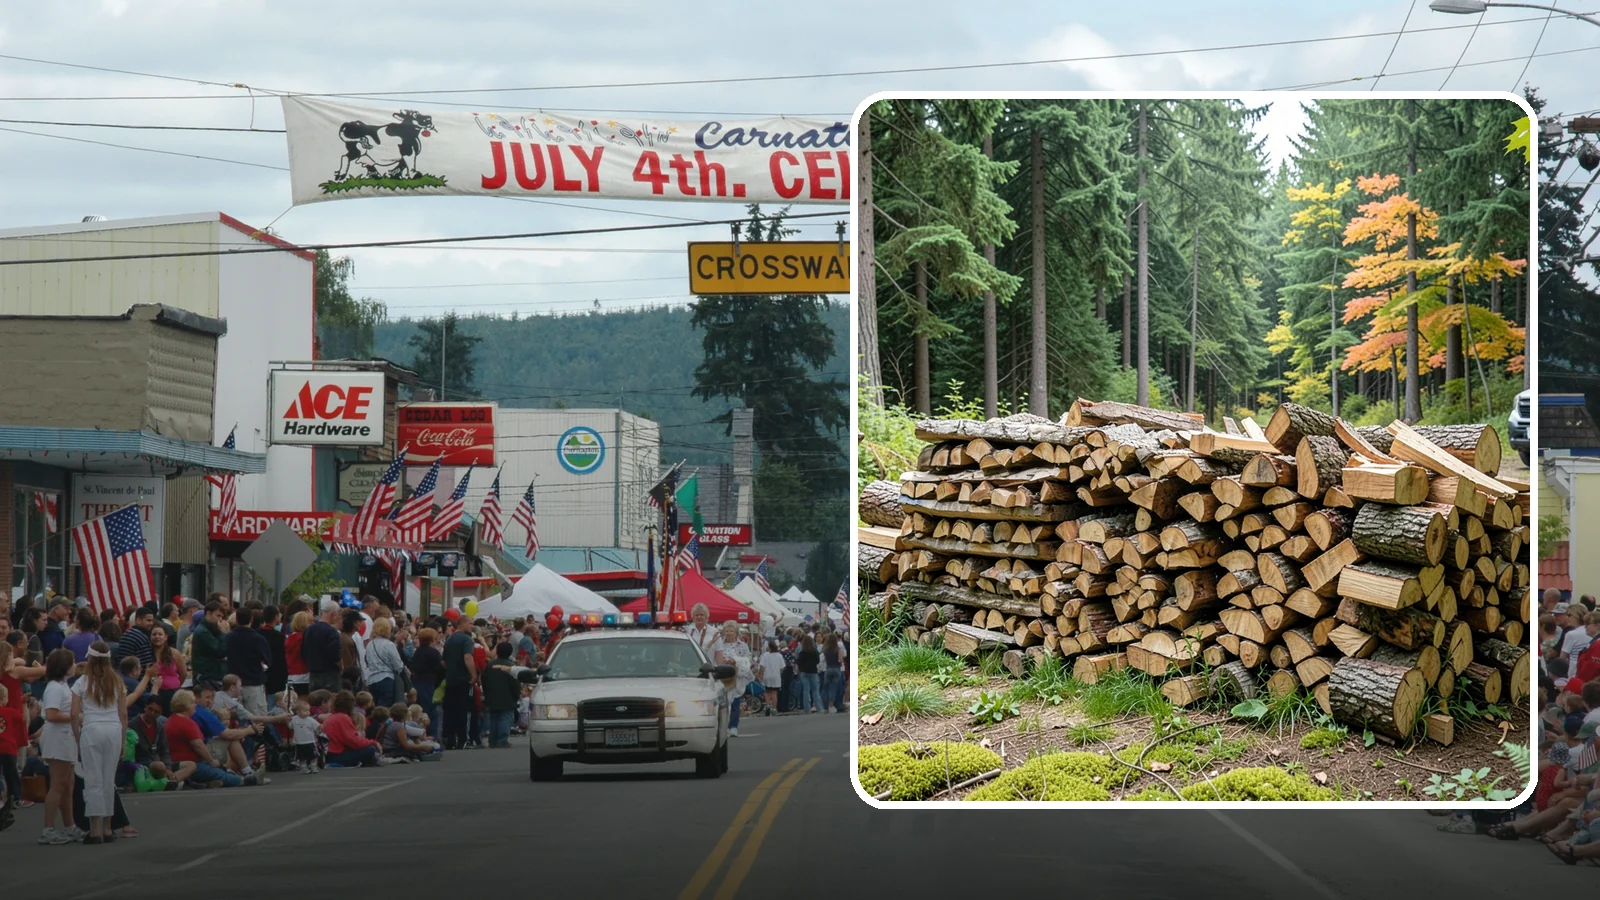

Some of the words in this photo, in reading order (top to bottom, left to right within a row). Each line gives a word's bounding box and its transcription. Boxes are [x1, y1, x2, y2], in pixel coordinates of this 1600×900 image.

[695, 121, 850, 150] Carnat
[481, 141, 605, 192] JULY
[632, 149, 747, 197] 4th.
[697, 254, 850, 280] CROSSWA
[283, 380, 373, 420] ACE
[406, 410, 452, 421] CEDAR
[283, 420, 371, 437] Hardware
[416, 428, 477, 447] Coca-Cola
[353, 467, 386, 480] Simpl
[95, 485, 124, 495] Vincent
[126, 486, 136, 494] de
[137, 486, 155, 495] Paul
[81, 503, 154, 522] THT
[688, 527, 741, 535] CRNATION
[699, 535, 730, 544] GLASS
